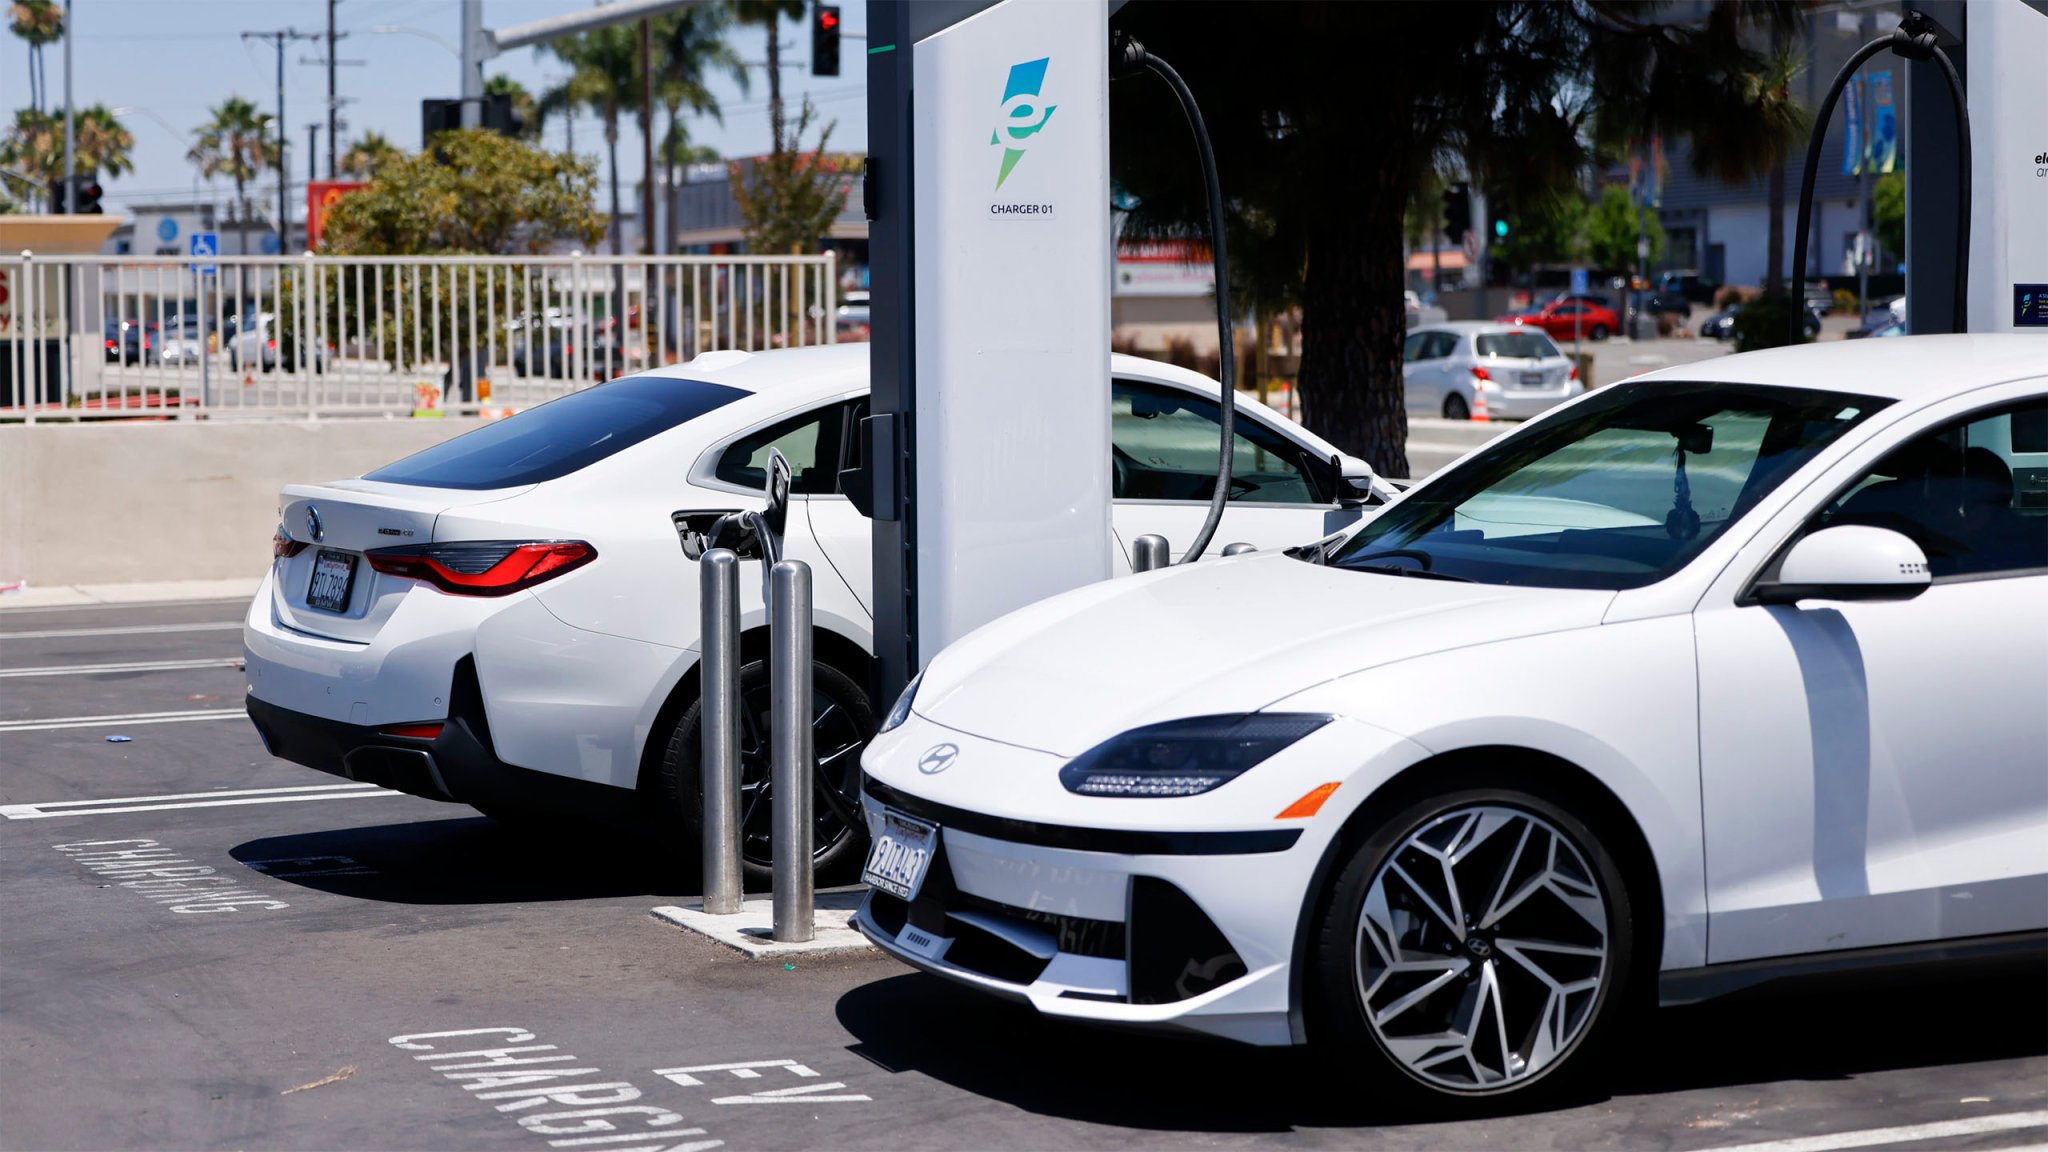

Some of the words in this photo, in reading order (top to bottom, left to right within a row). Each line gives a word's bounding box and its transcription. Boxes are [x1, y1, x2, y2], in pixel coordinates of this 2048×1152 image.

[2034, 151, 2048, 165] el
[990, 204, 1039, 214] CHARGER
[1041, 204, 1053, 214] 01
[51, 839, 290, 914] CHARGING
[652, 1059, 872, 1105] EV
